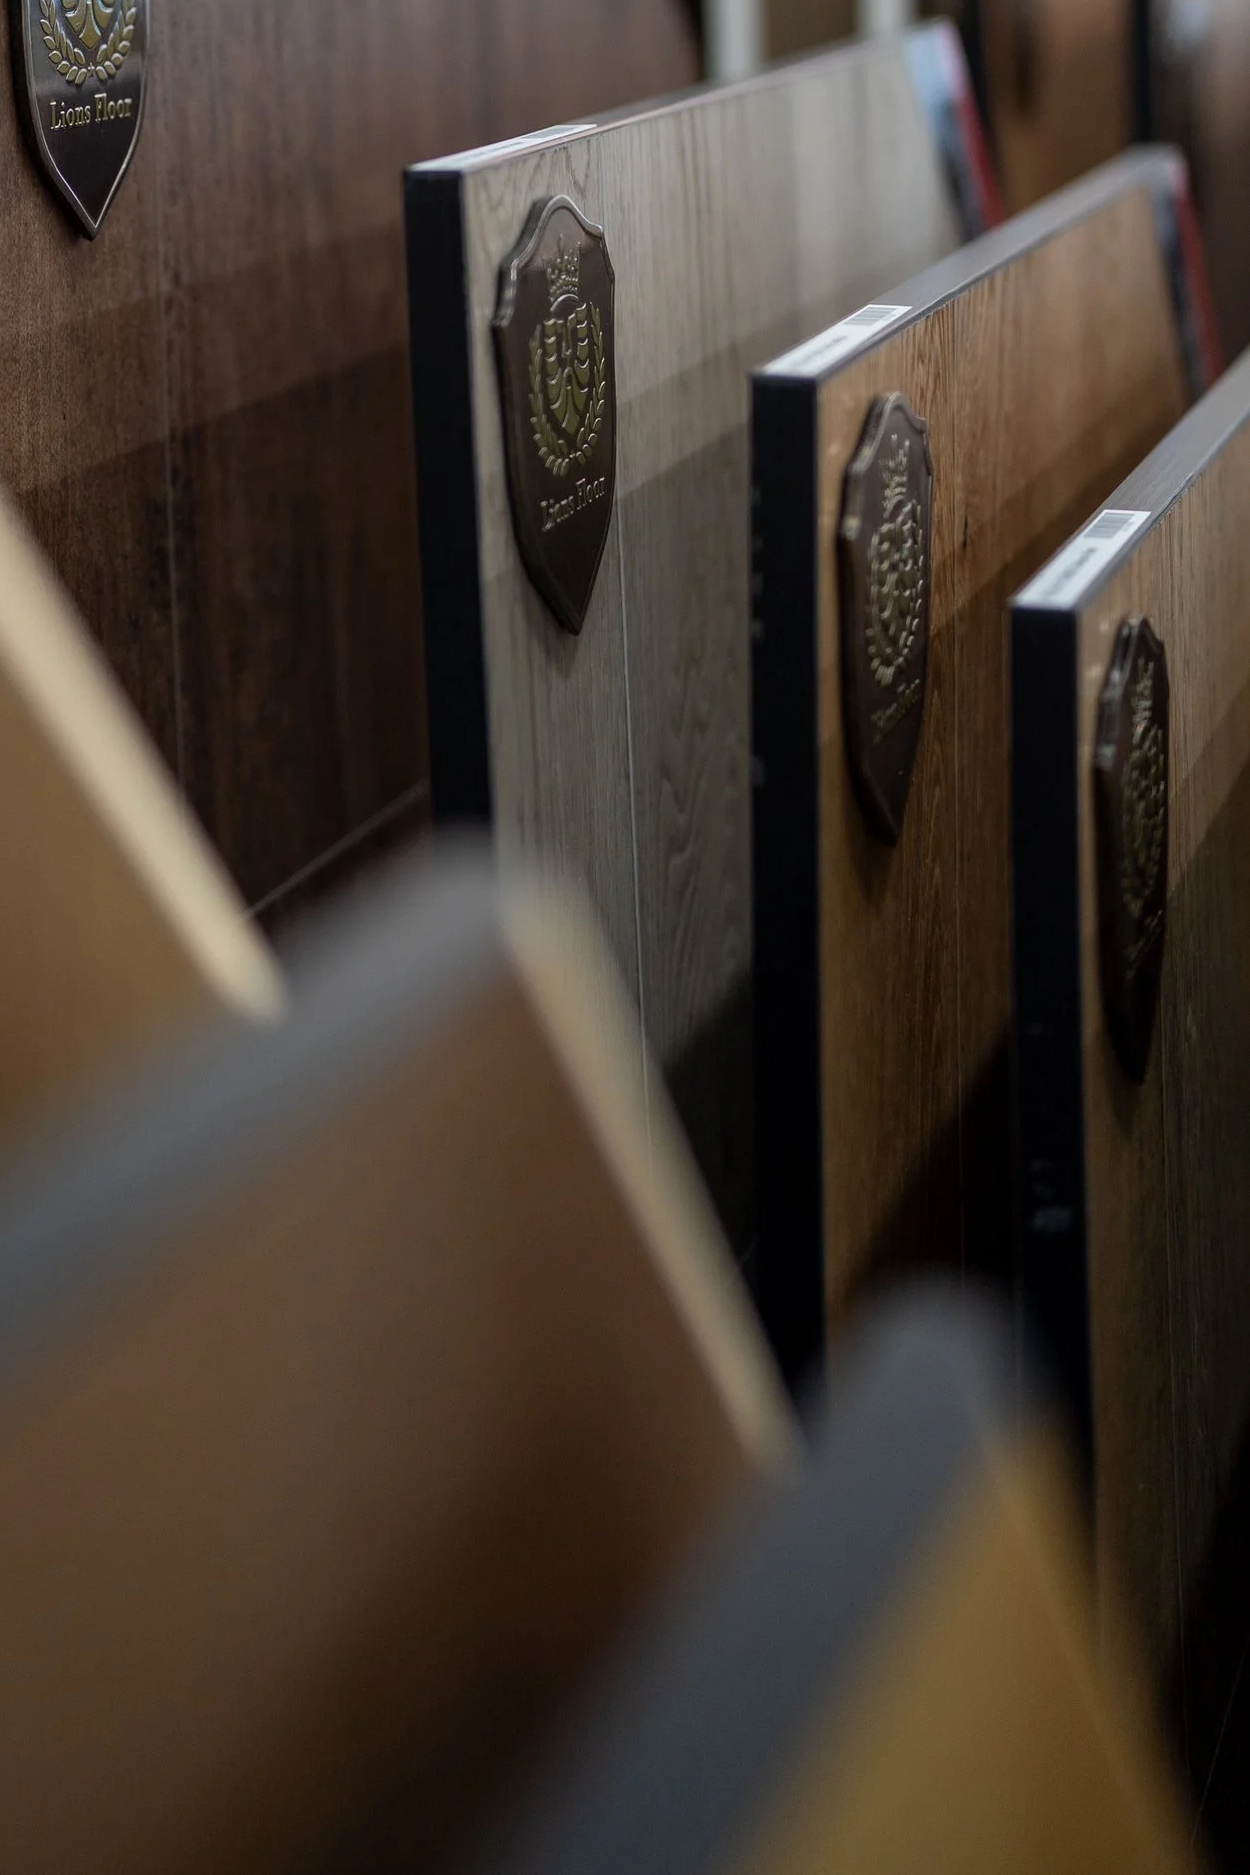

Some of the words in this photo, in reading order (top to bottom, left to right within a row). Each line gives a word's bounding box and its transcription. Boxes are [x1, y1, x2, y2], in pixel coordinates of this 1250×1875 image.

[50, 101, 91, 130] Lions
[94, 92, 132, 122] Floor
[540, 496, 574, 532] Lions
[576, 477, 605, 510] Floor
